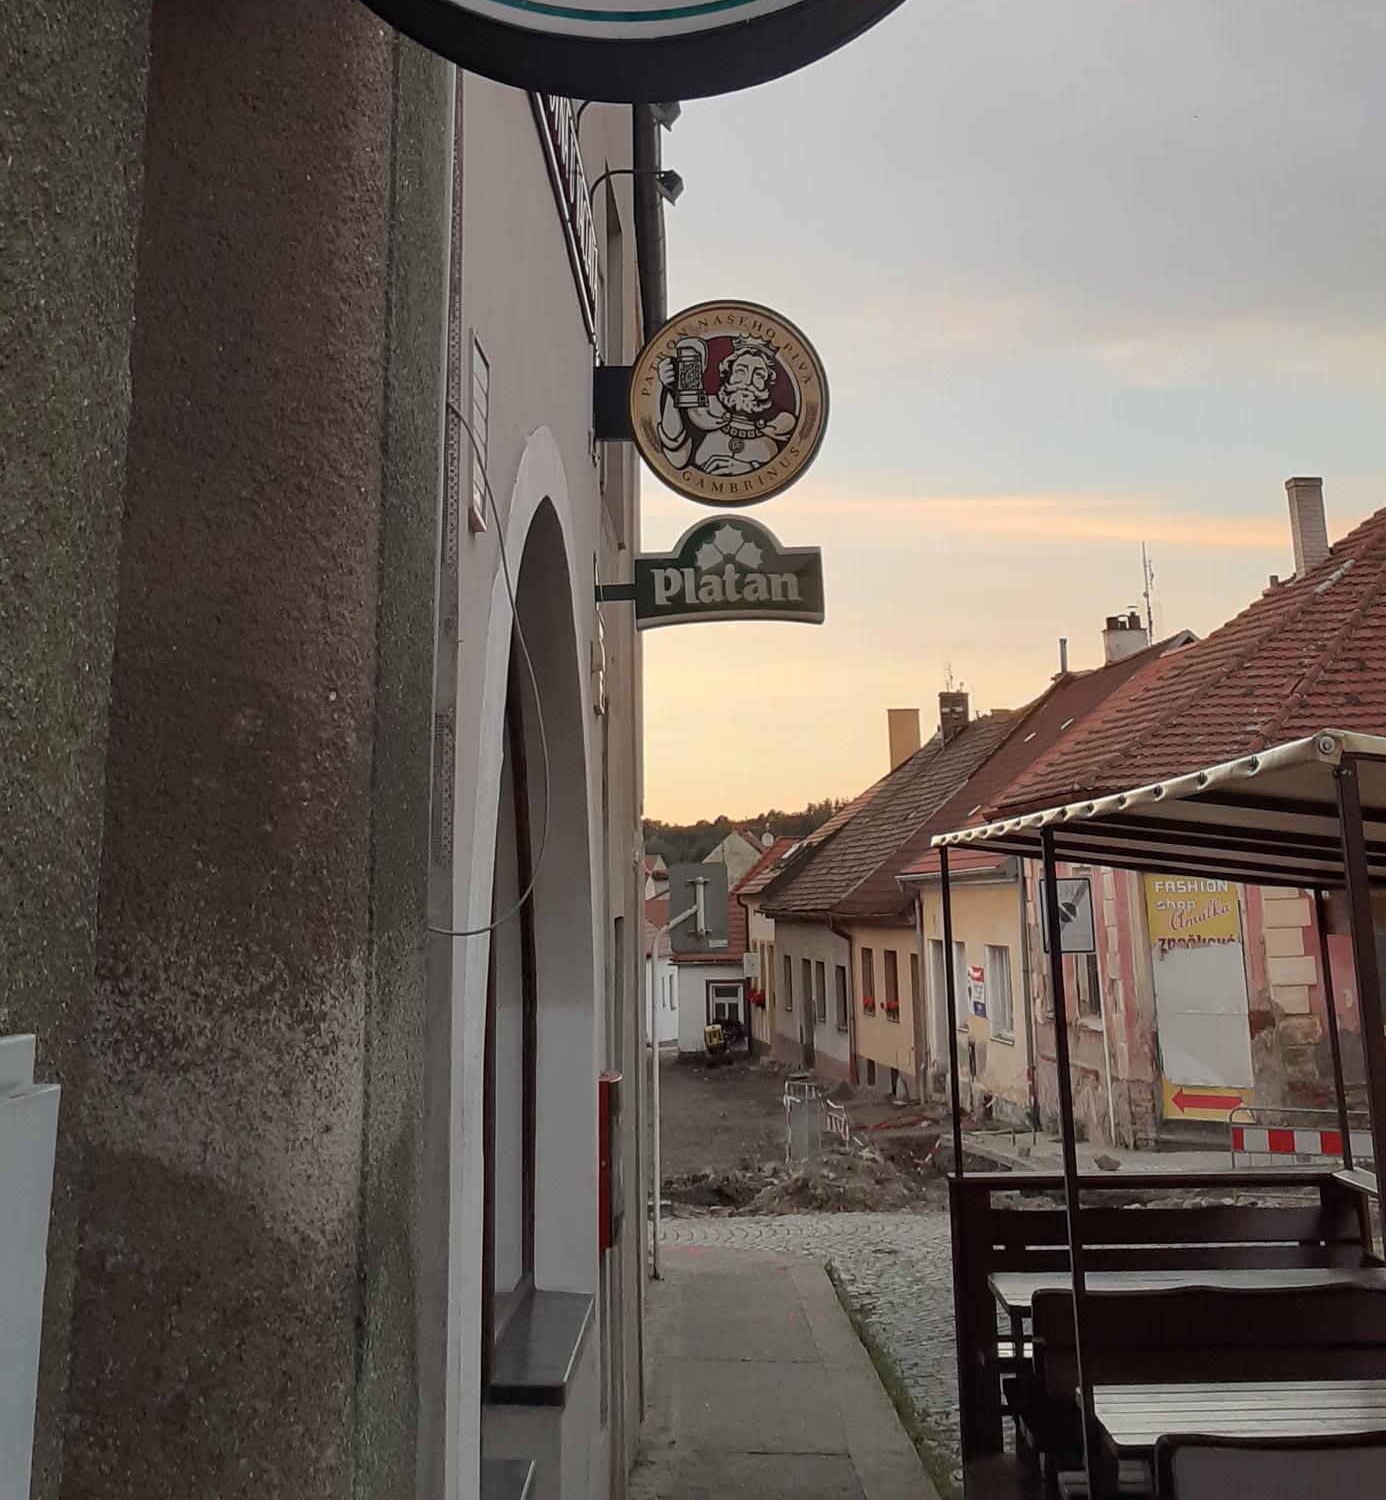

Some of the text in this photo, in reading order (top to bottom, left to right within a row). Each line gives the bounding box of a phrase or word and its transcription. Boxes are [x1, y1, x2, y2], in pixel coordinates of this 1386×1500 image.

[641, 328, 690, 396] PATRON
[782, 343, 812, 385] PIVA
[682, 446, 801, 493] GAMBRINUS
[651, 563, 802, 605] Platan
[1155, 880, 1228, 893] FASHION
[1156, 898, 1196, 912] shop
